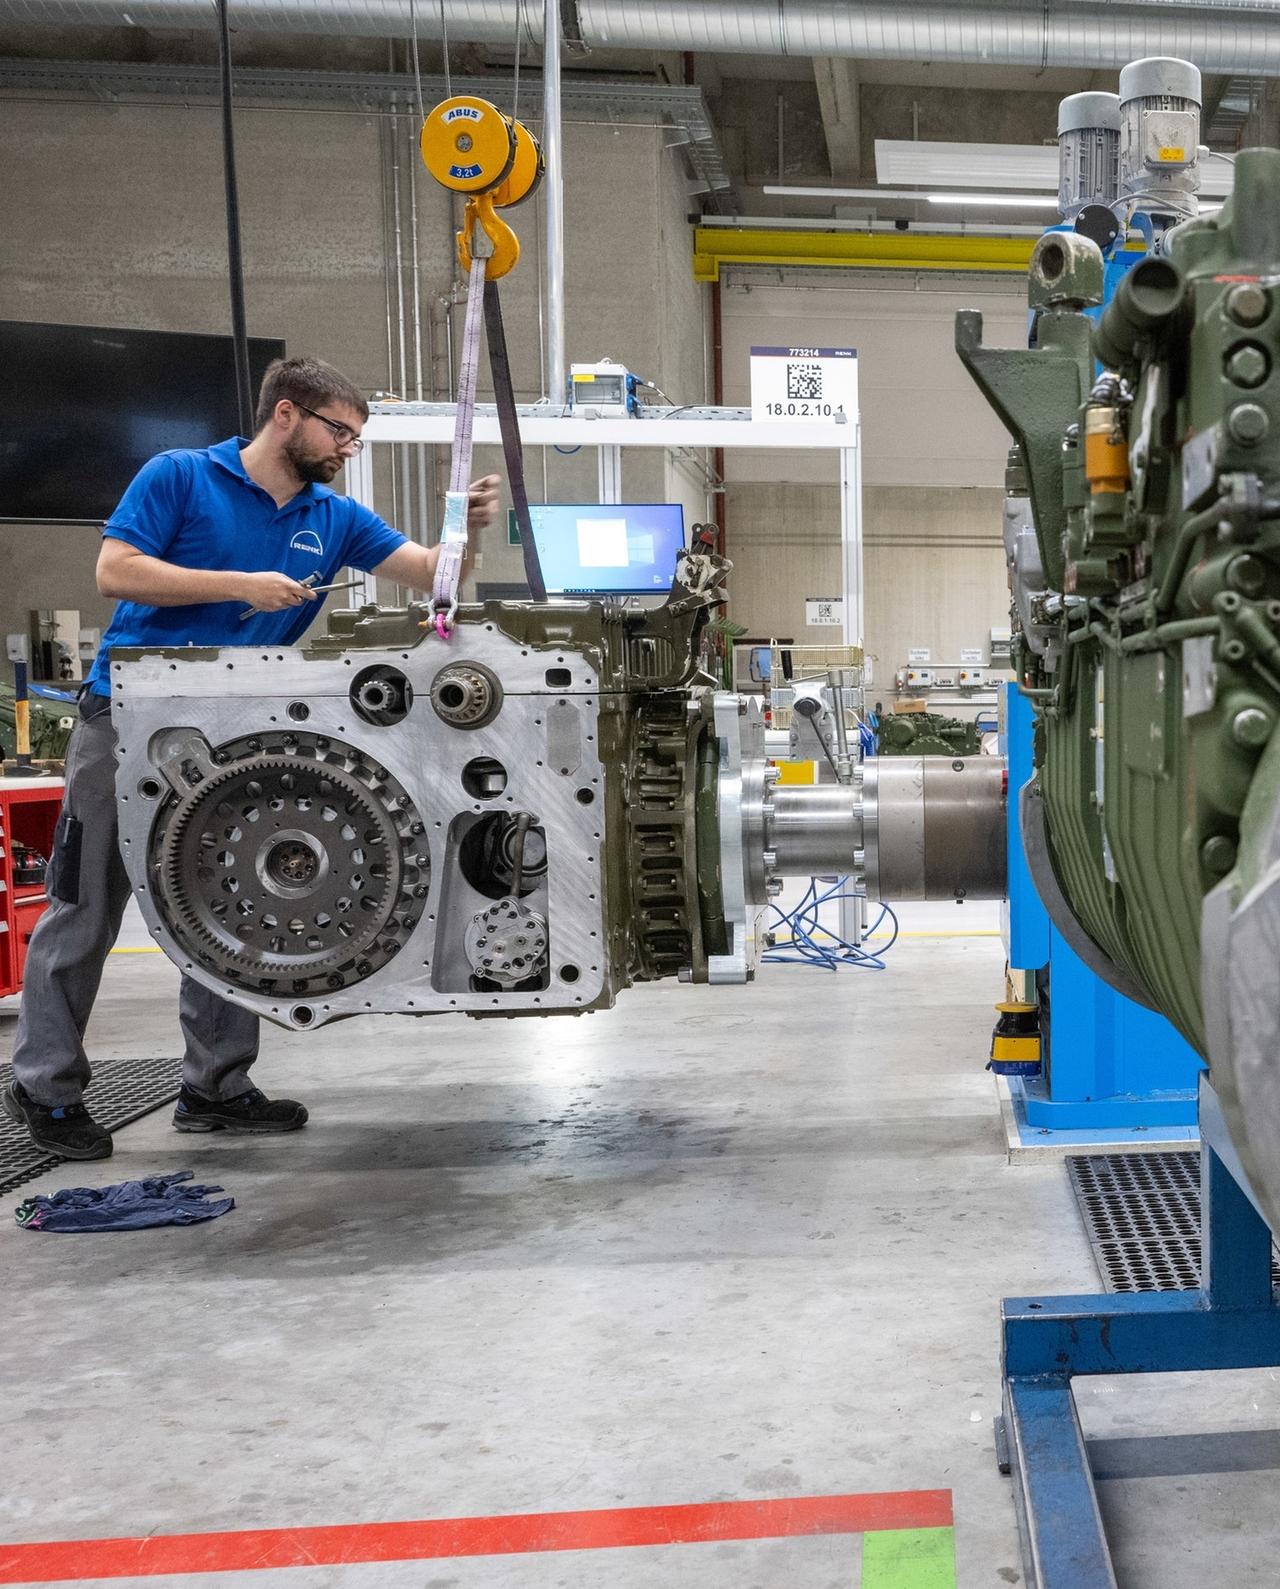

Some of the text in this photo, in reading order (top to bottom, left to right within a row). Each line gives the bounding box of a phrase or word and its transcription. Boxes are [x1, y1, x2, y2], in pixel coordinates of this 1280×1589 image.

[448, 109, 479, 121] ABUS
[456, 168, 473, 178] 3,2t
[789, 348, 820, 357] 773214
[766, 403, 844, 416] 18.0.2.10.1
[293, 542, 321, 555] RENK
